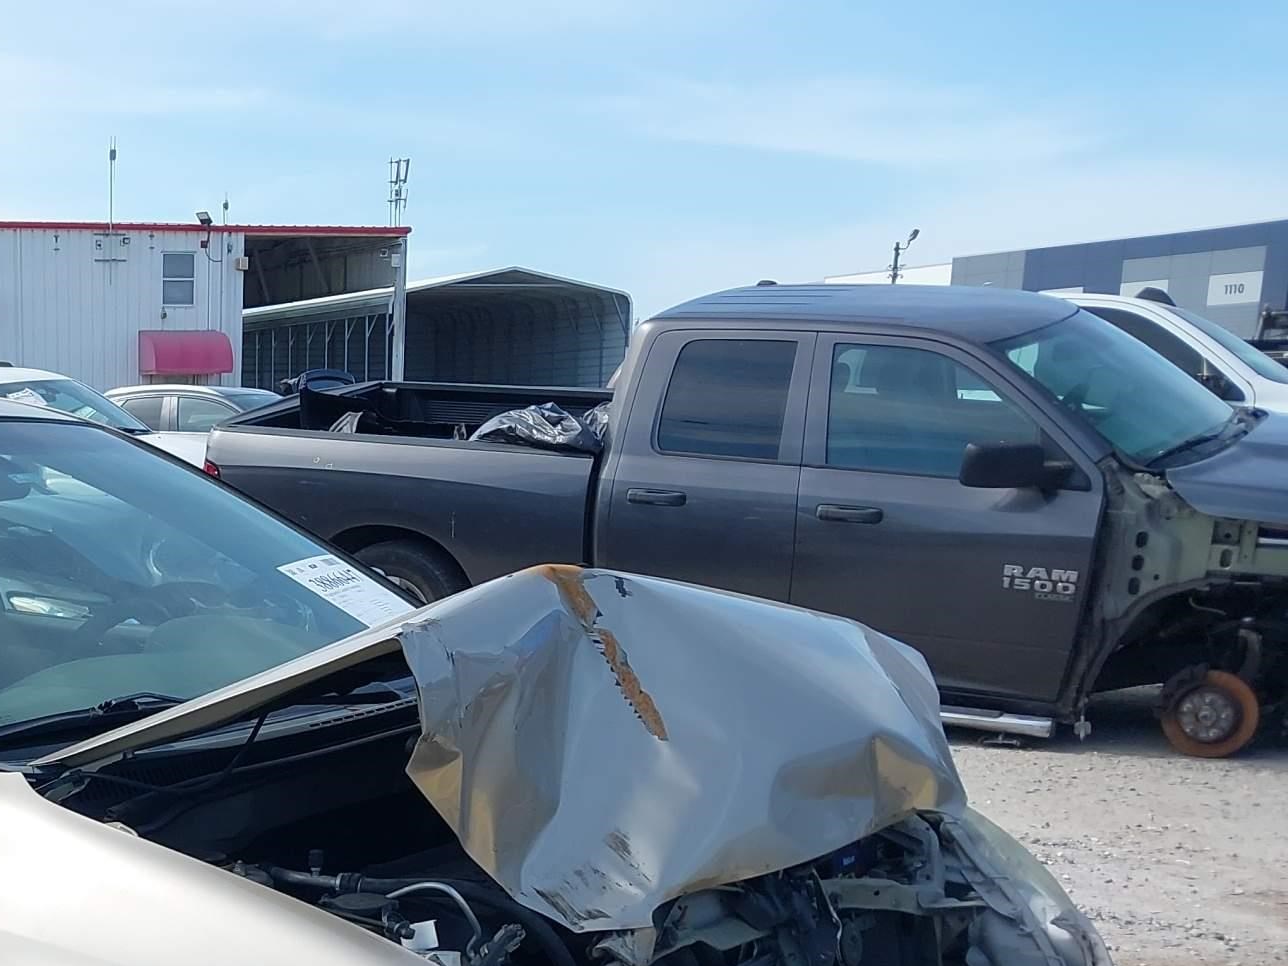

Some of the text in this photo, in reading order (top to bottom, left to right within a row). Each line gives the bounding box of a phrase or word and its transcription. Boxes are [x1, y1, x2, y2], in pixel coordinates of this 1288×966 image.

[1224, 283, 1245, 295] 1110
[1003, 564, 1079, 582] RAM
[1002, 576, 1076, 594] 1500
